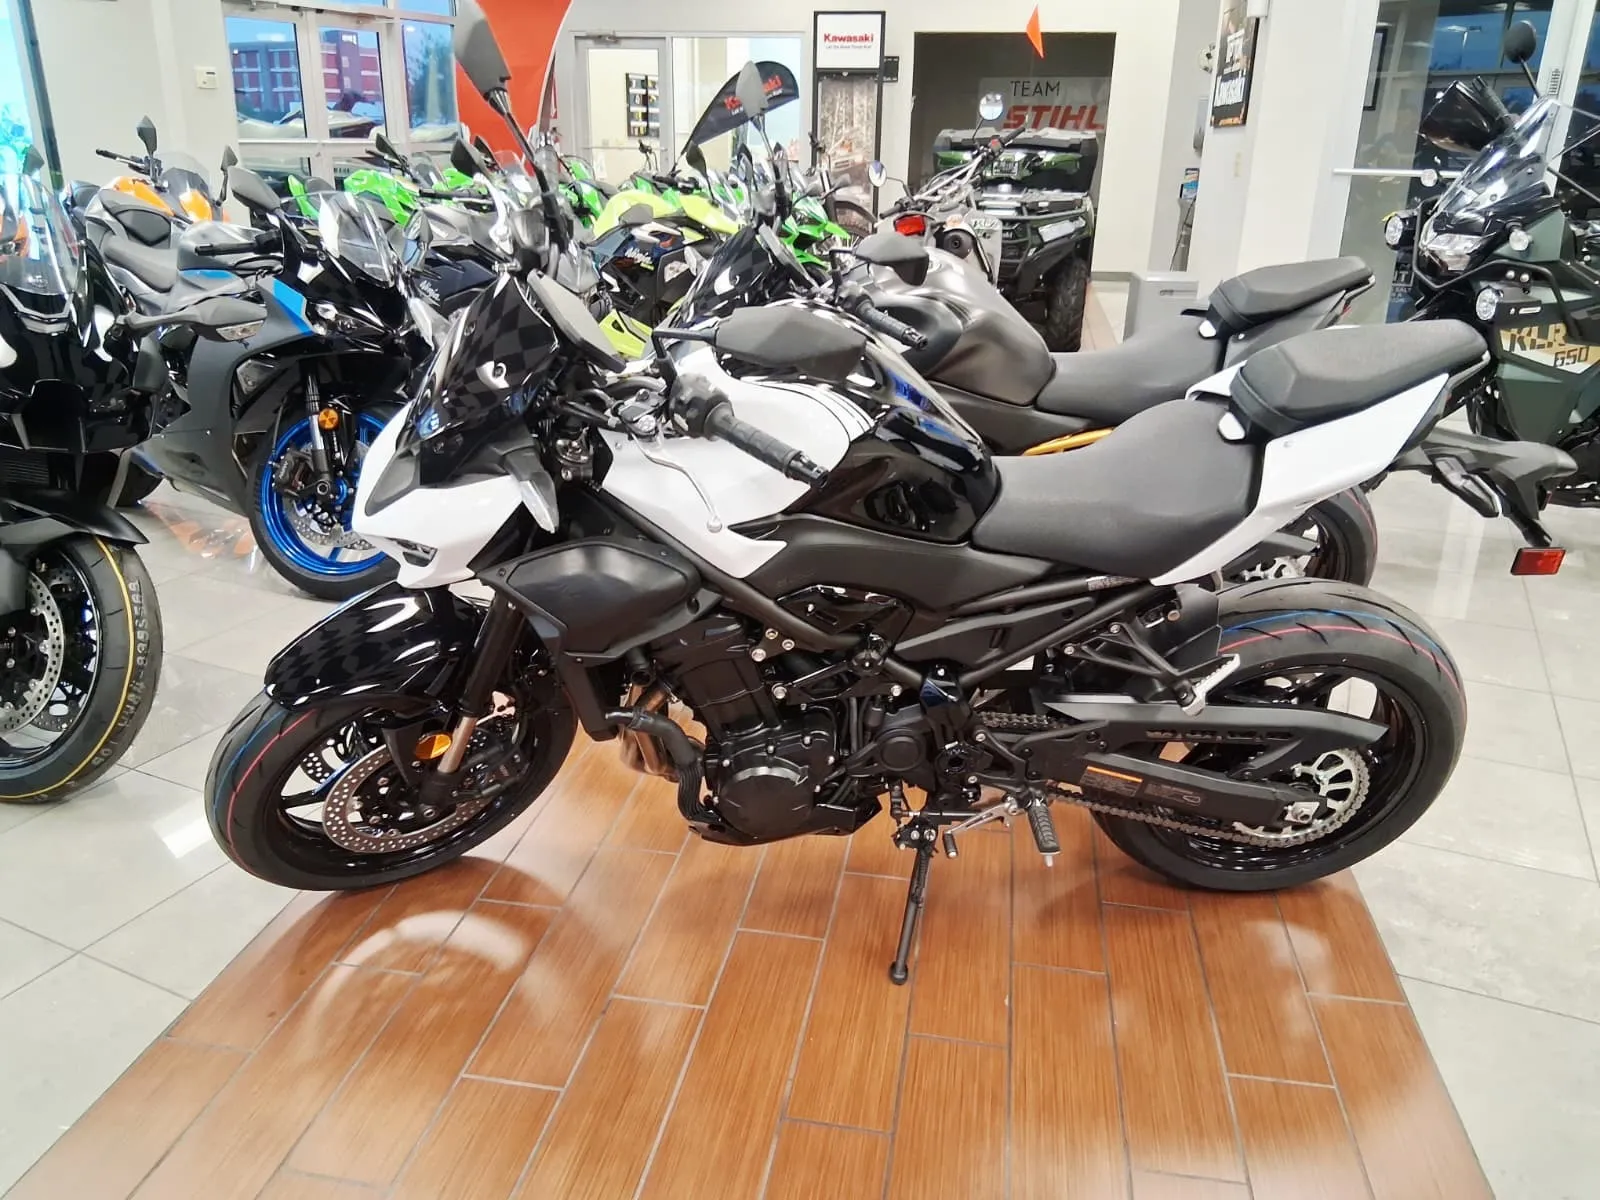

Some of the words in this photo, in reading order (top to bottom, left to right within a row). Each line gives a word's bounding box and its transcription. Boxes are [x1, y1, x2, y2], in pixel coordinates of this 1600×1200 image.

[823, 33, 874, 43] Kawasaki
[1010, 80, 1060, 97] TEAM
[1003, 104, 1104, 130] STIHL
[1508, 322, 1567, 352] KLR
[1554, 346, 1590, 368] 650
